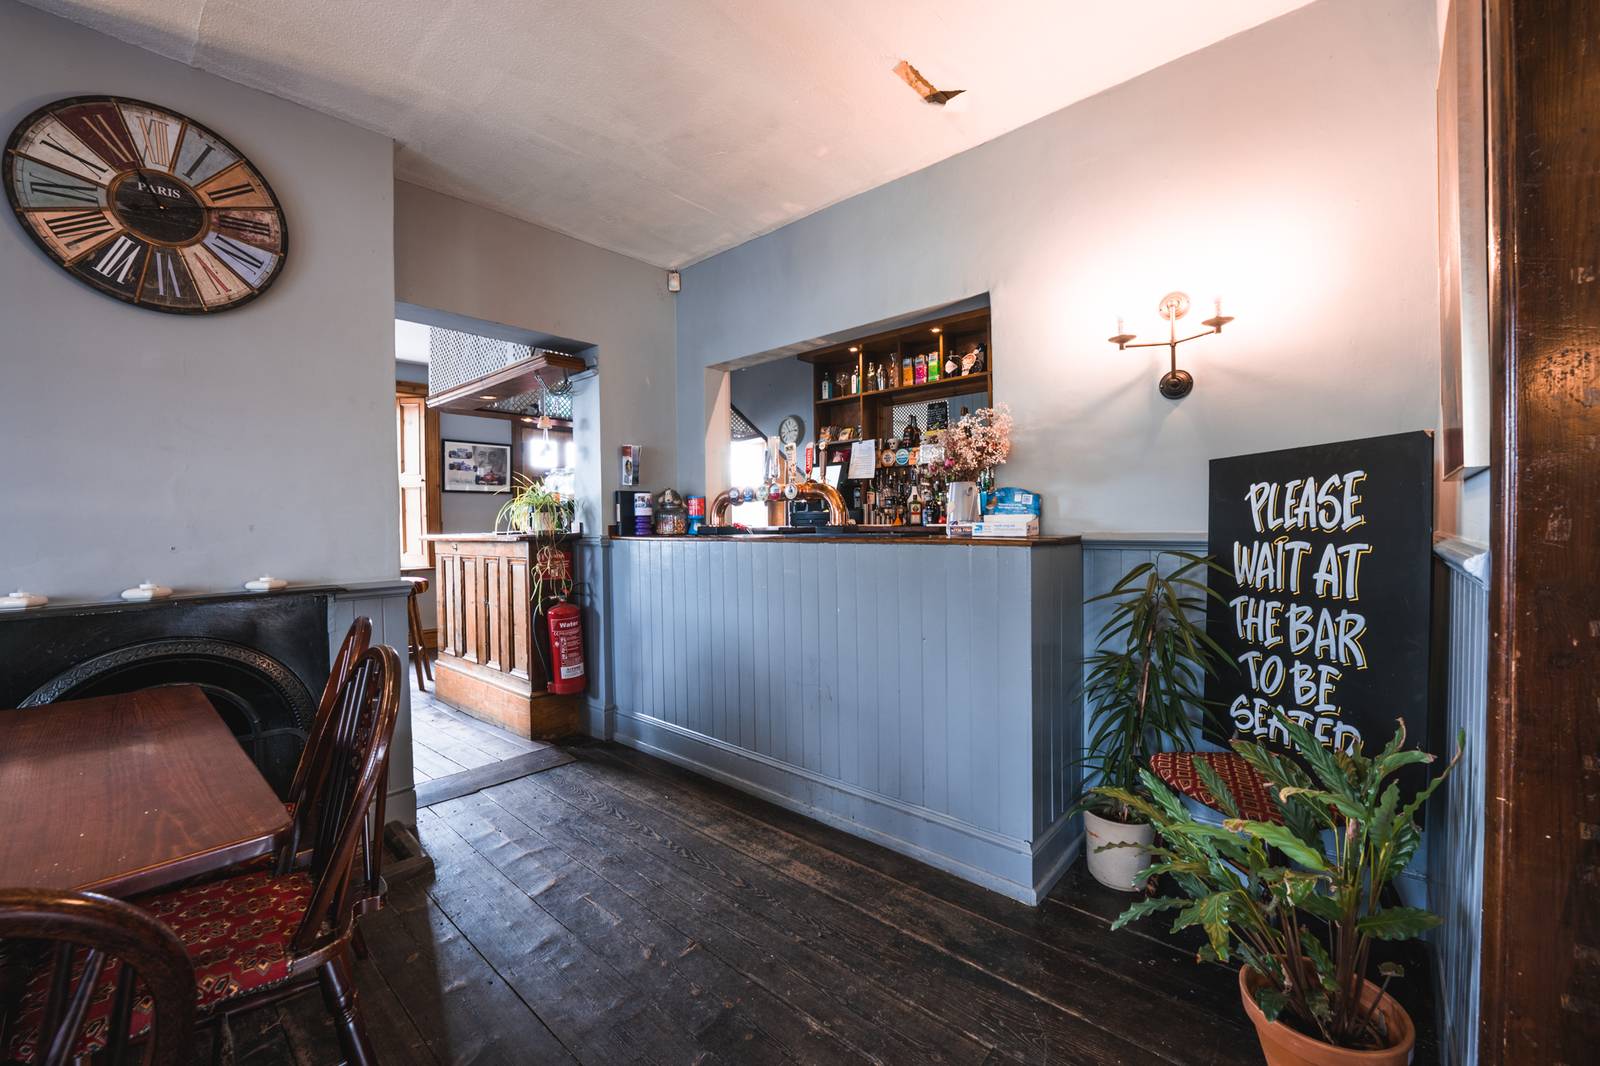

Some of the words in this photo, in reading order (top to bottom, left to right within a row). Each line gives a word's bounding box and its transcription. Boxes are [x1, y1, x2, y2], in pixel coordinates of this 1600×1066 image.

[39, 132, 109, 180] X
[135, 115, 170, 168] XII
[182, 143, 216, 180] I
[137, 181, 181, 199] PARIS
[205, 181, 256, 204] II
[217, 213, 270, 238] III
[1244, 470, 1368, 534] PLEASE
[1233, 536, 1312, 595] WAIT
[1313, 543, 1372, 602] AT
[559, 620, 579, 629] Water
[1229, 595, 1285, 649] THE
[1285, 602, 1368, 670] BAR
[1238, 651, 1286, 697] TO
[1288, 659, 1343, 716] BE
[1230, 693, 1364, 758] SEATED
